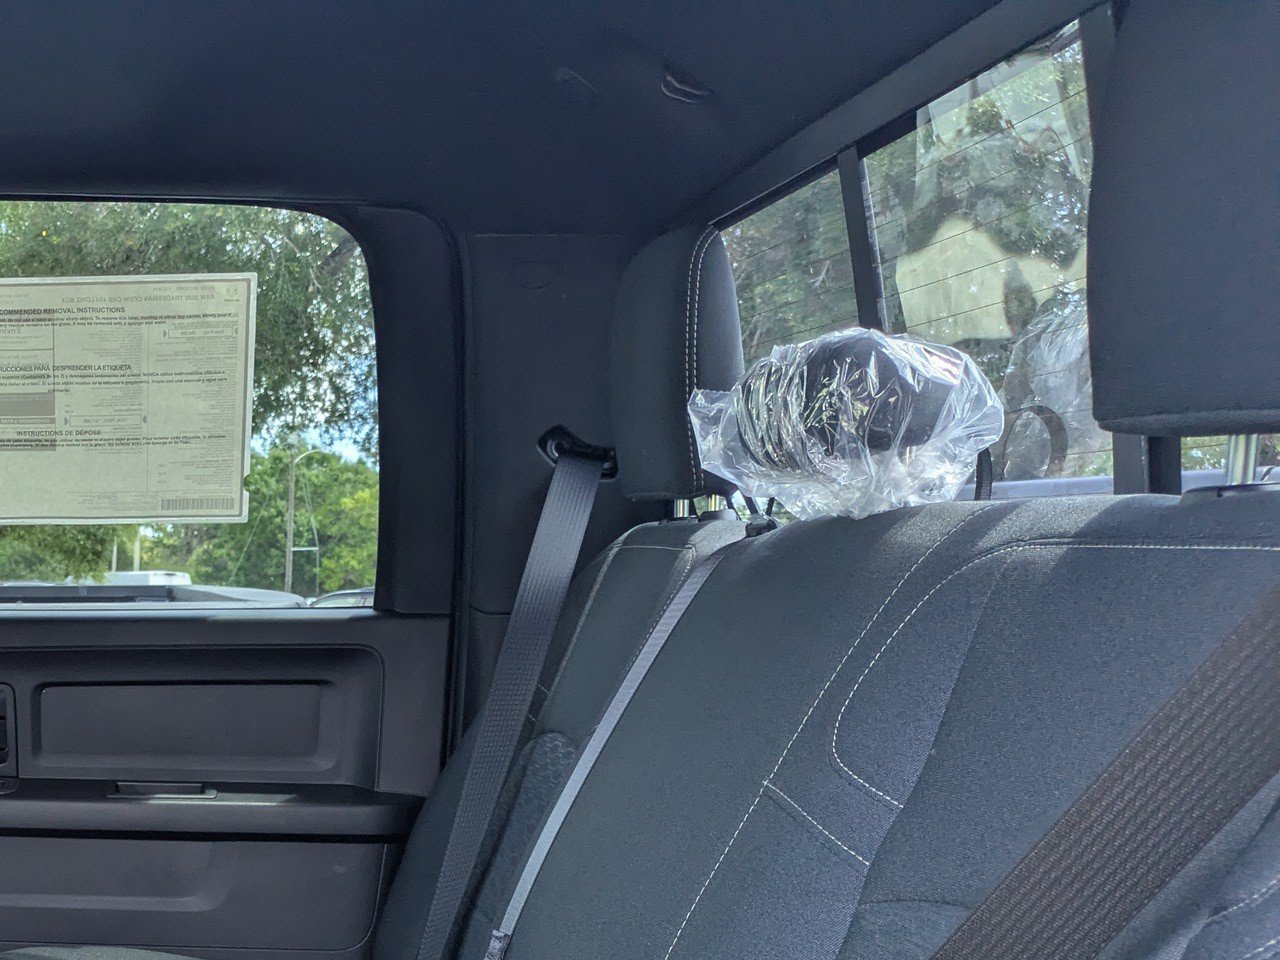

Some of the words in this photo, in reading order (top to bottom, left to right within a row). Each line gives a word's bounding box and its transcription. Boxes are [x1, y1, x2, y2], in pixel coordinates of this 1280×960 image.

[43, 307, 76, 315] REMOVAL
[76, 306, 126, 314] INSTRUCTIONS
[52, 364, 93, 372] DESPRENDER
